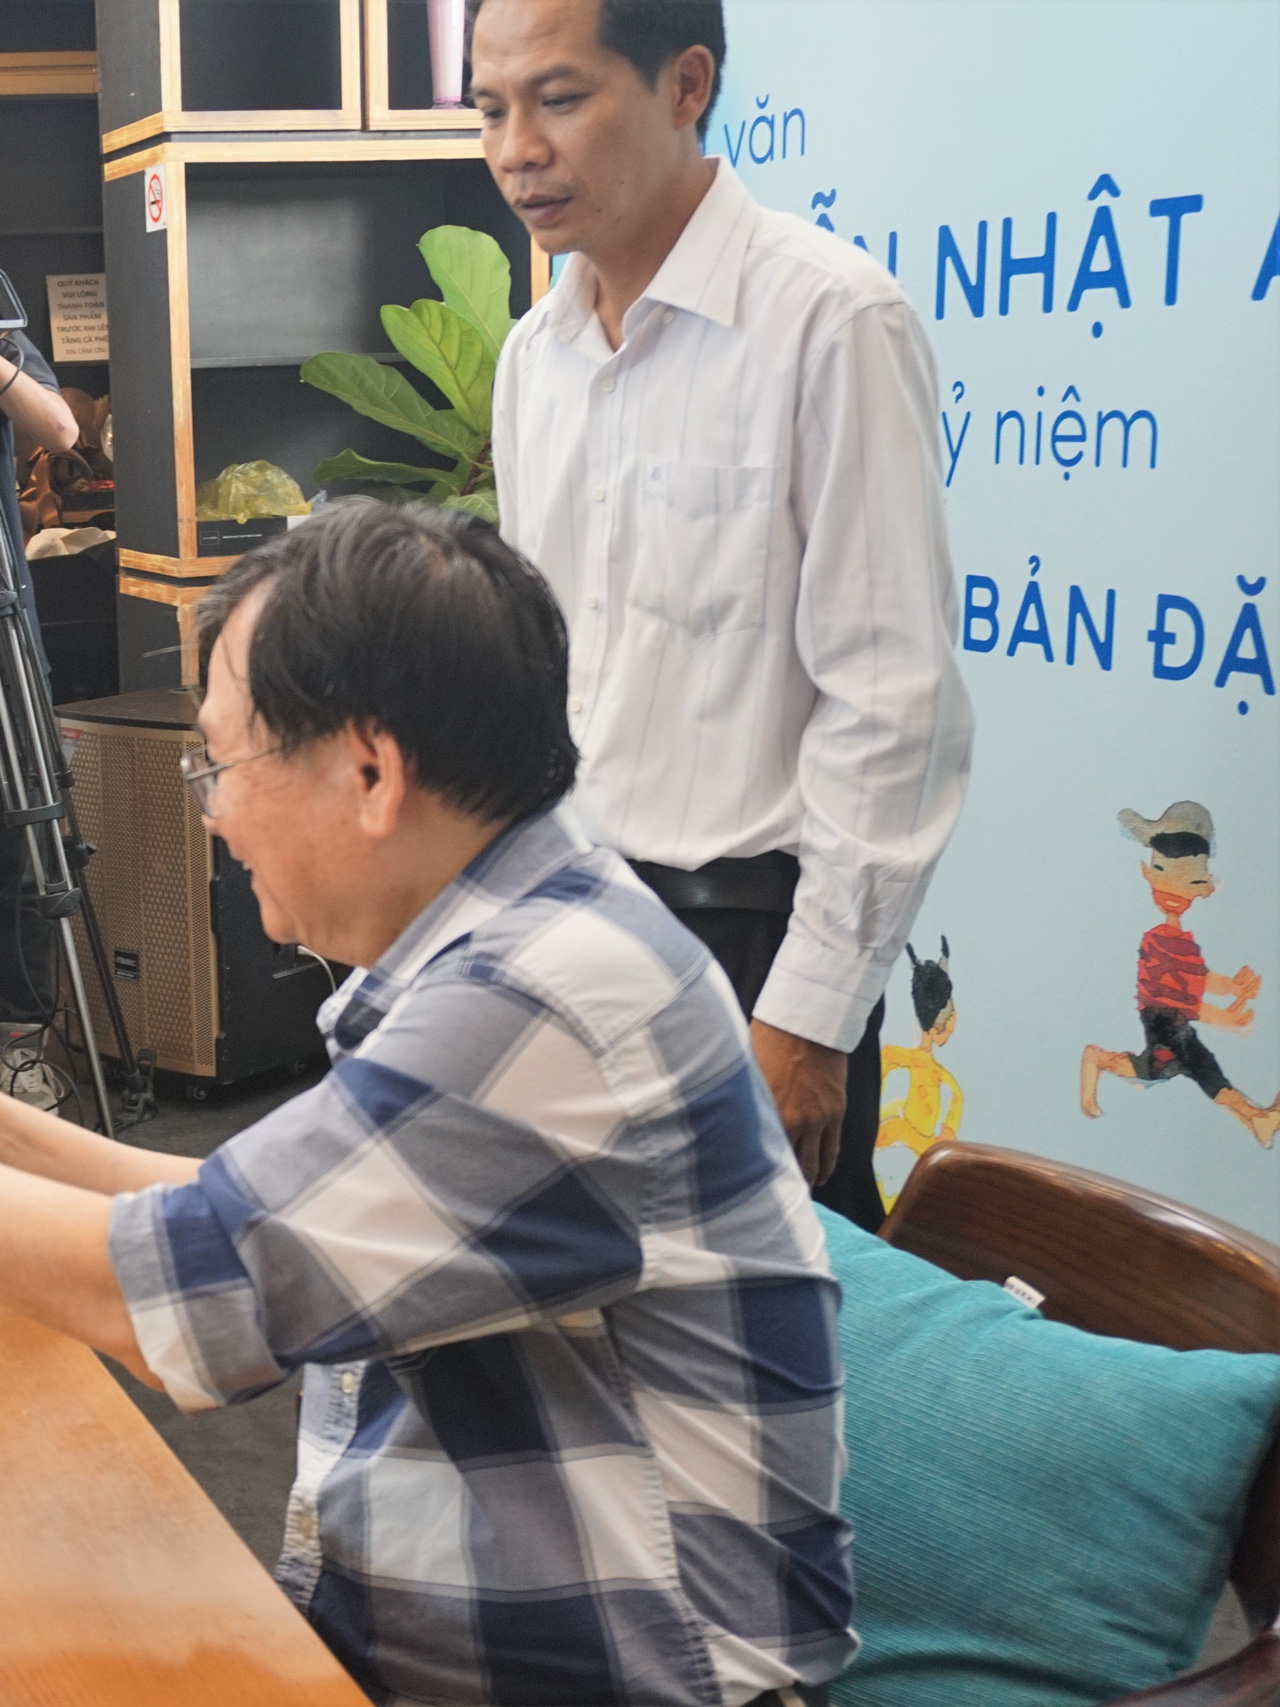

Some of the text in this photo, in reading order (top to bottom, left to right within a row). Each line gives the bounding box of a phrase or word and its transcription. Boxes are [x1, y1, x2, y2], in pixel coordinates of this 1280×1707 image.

[723, 93, 807, 169] văn
[934, 173, 1203, 339] NHẬT
[941, 380, 1158, 488] ỷ niệm
[962, 554, 1277, 716] BẢN ĐẶ
